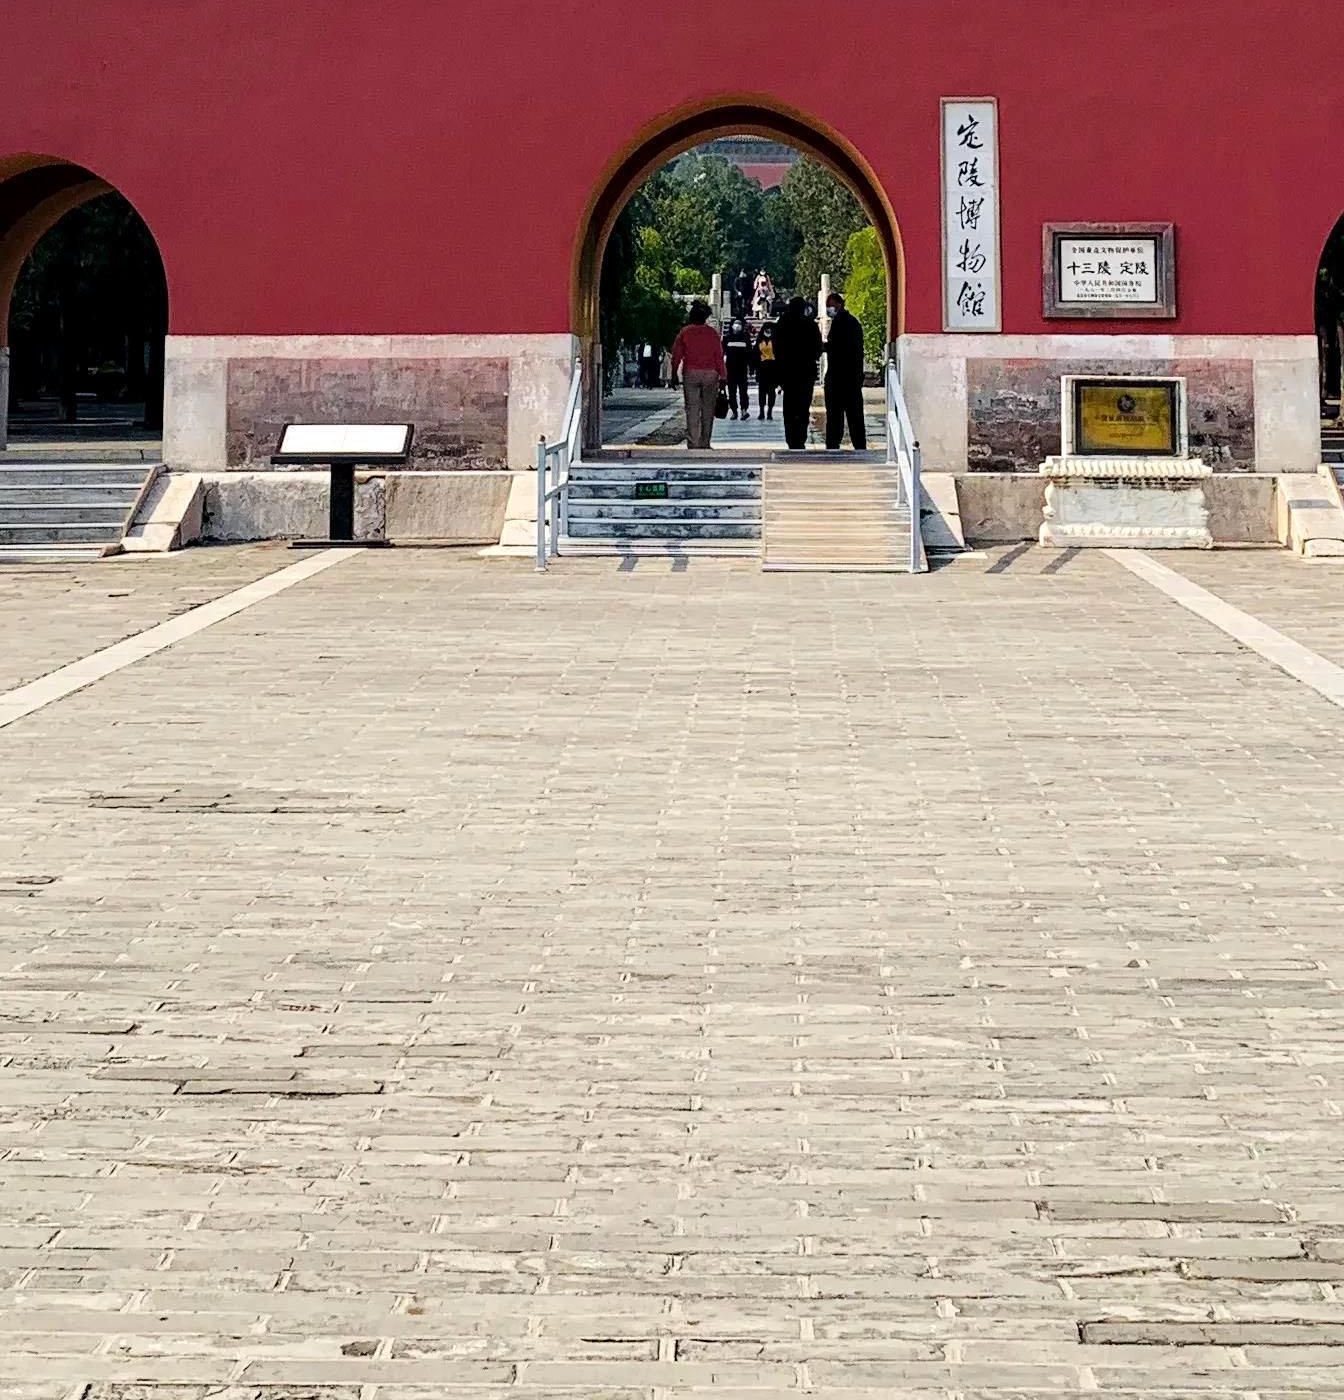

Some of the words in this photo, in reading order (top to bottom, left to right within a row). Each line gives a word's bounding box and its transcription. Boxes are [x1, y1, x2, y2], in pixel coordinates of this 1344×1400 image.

[1067, 261, 1111, 276] 十三陵
[1120, 261, 1149, 275] 定陵
